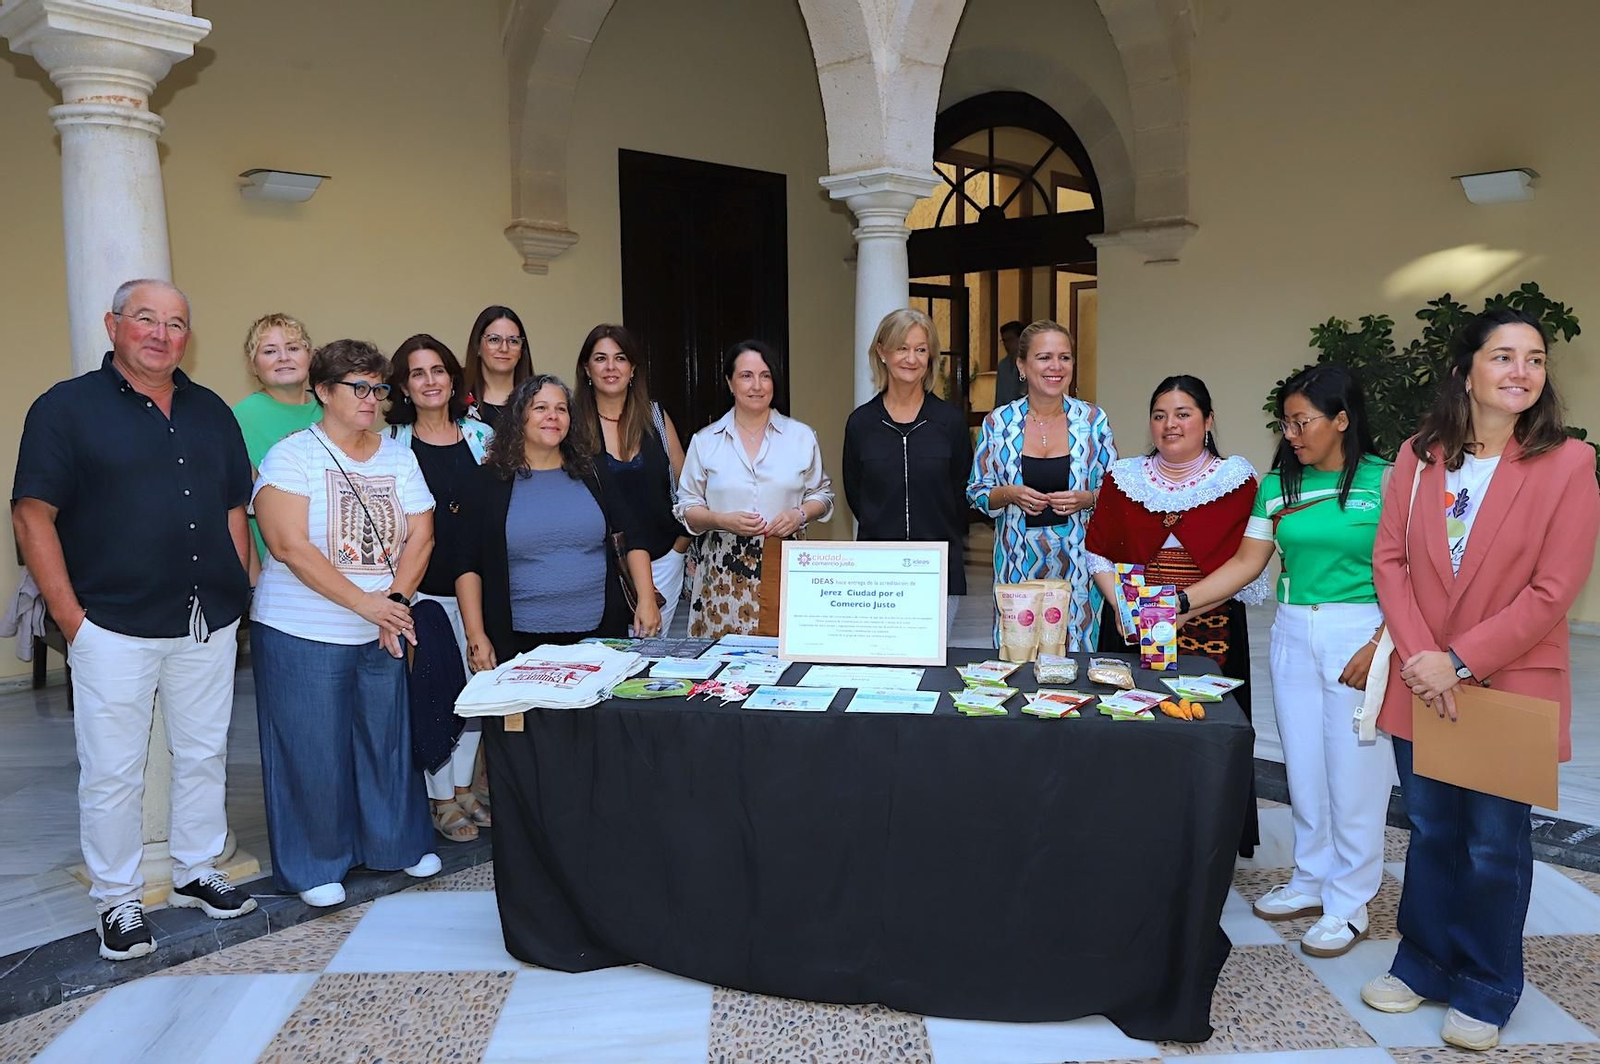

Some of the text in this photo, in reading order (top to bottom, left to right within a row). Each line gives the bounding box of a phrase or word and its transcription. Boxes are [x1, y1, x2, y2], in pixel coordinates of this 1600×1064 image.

[811, 577, 835, 585] IDEAS
[820, 588, 842, 598] Jerez
[846, 589, 877, 597] Ciudad
[878, 590, 894, 598] por
[830, 600, 896, 610] Comercio Justo
